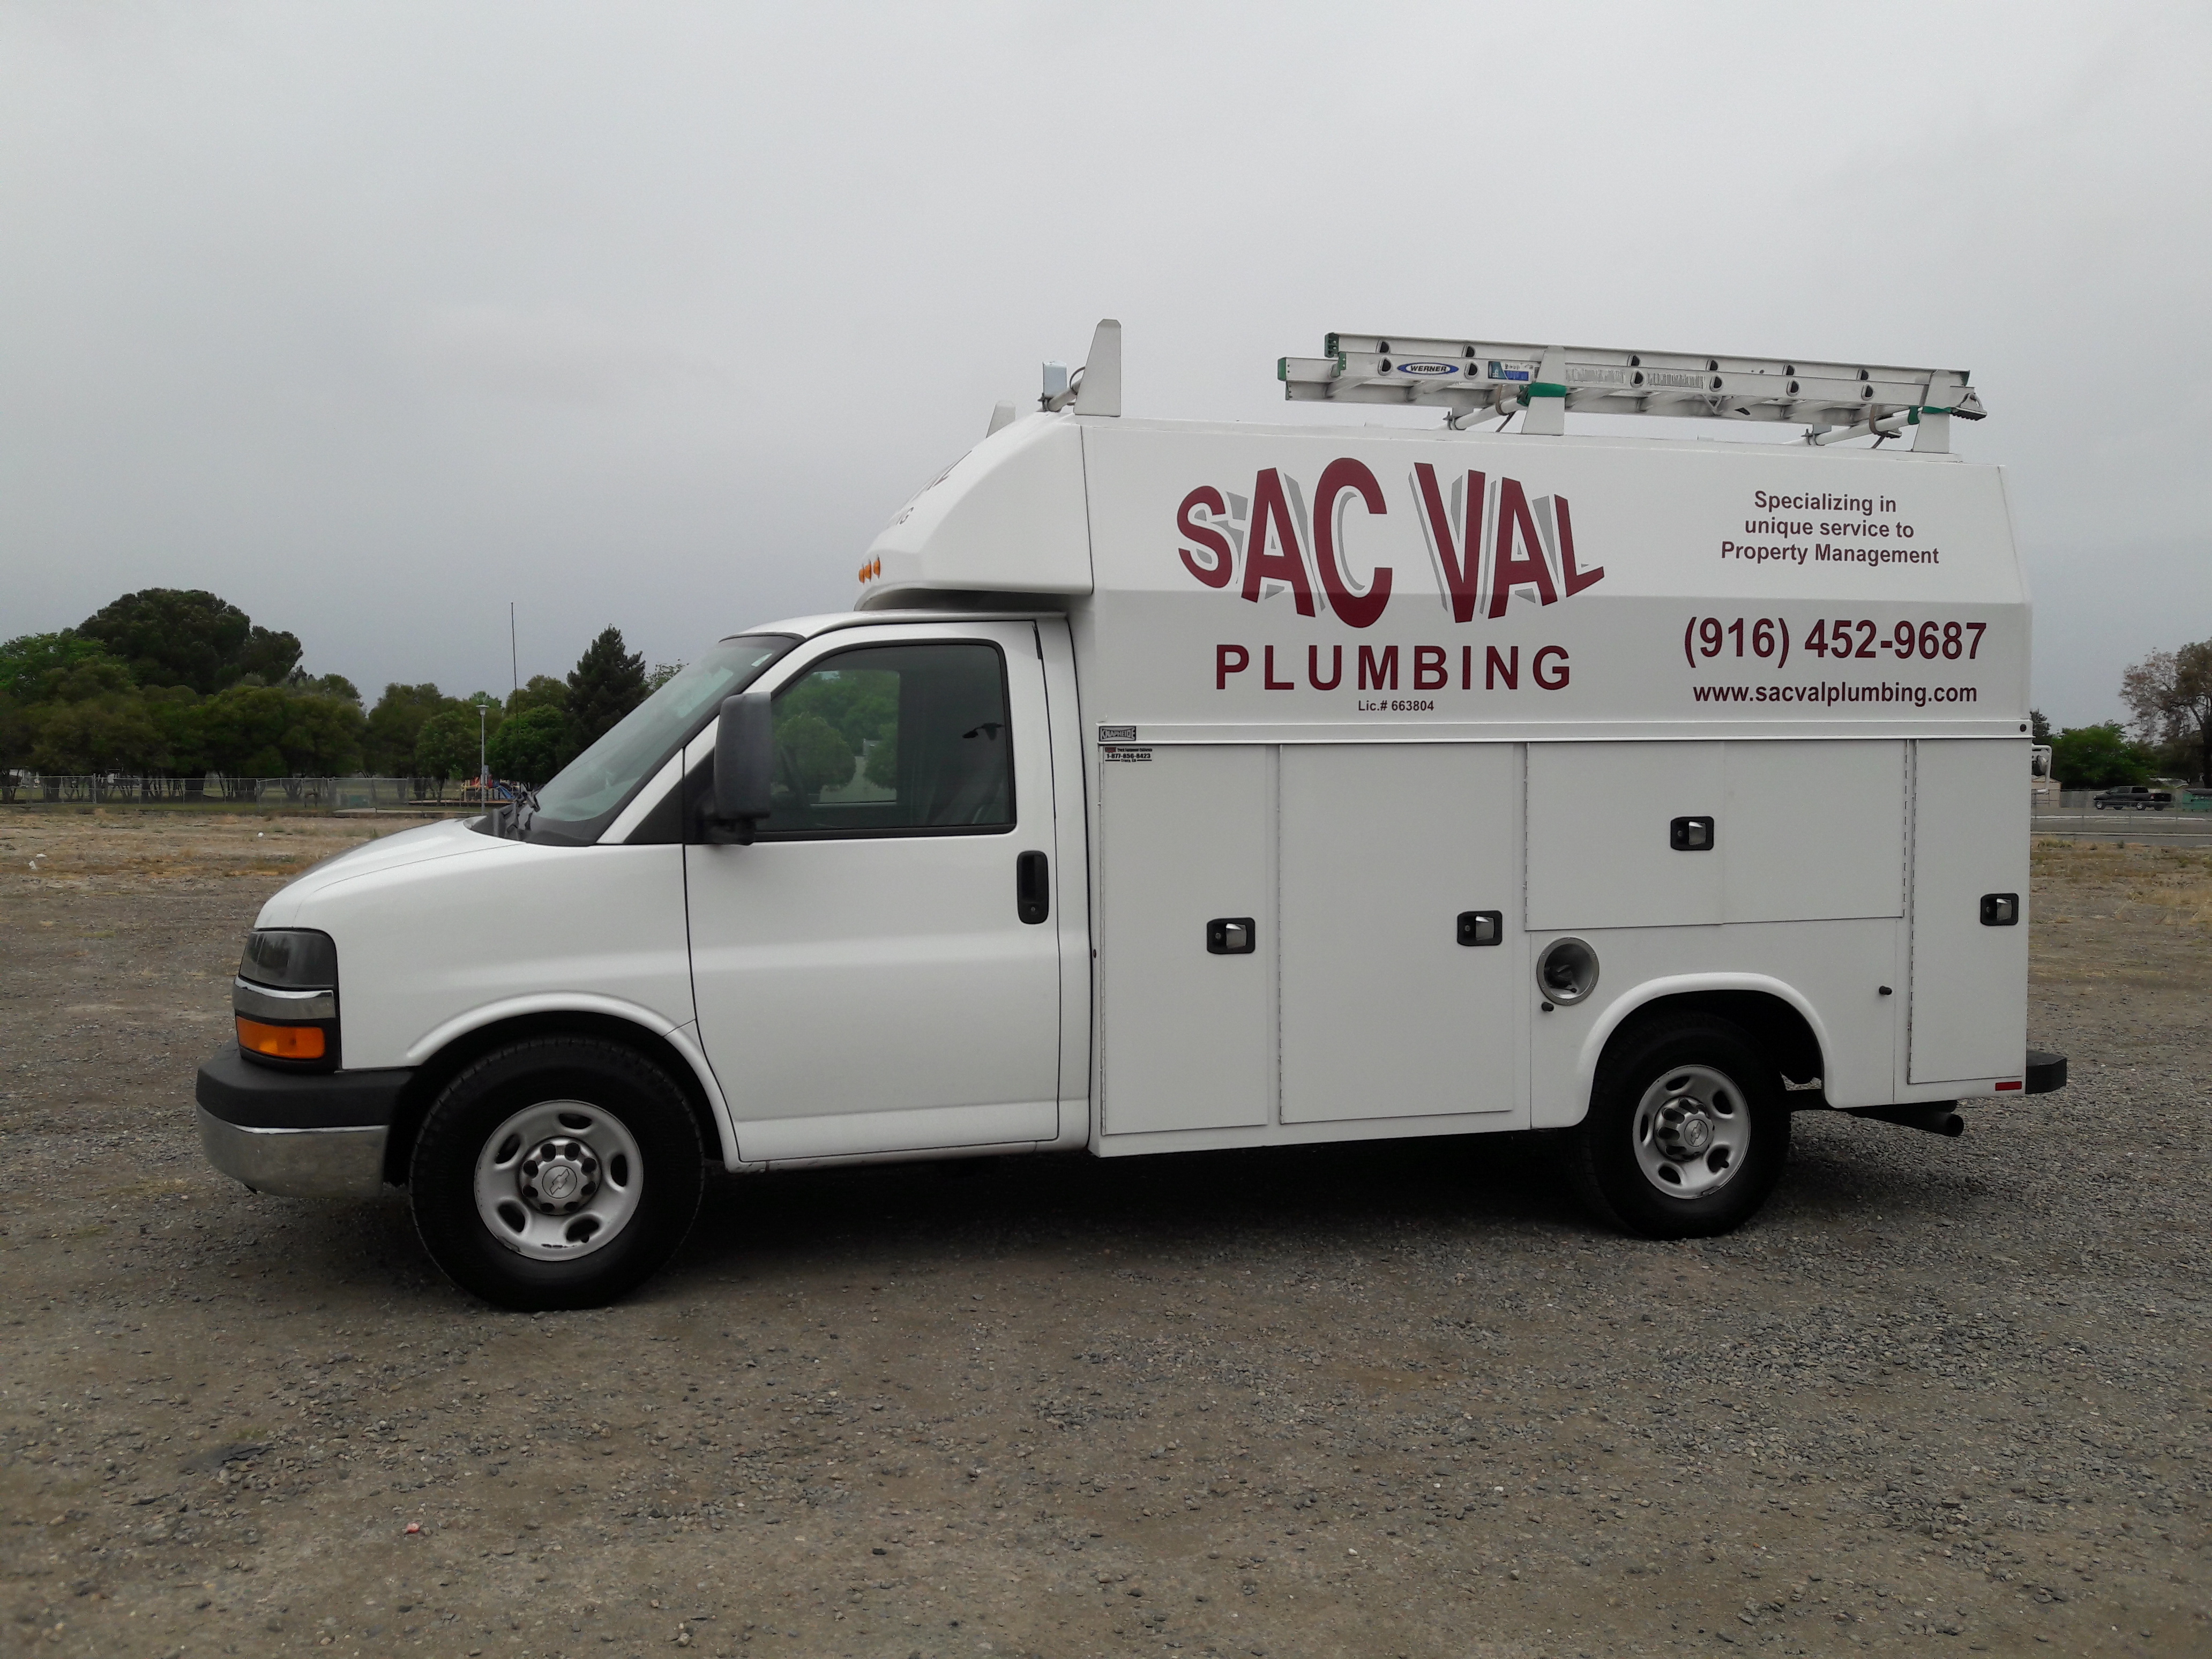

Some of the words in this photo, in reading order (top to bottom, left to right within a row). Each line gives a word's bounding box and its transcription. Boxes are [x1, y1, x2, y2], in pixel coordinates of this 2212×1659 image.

[1754, 490, 1873, 516] Specializing
[1880, 495, 1896, 512] in
[1745, 517, 1813, 539] unique
[1819, 520, 1889, 537] service
[1895, 521, 1914, 538] to
[1177, 458, 1393, 628] SAC
[1414, 462, 1604, 623] VAL
[1721, 541, 1809, 565] Property
[1815, 543, 1940, 567] Management
[1684, 616, 1790, 669] (916)
[1804, 618, 1987, 660] 452-9687
[1215, 644, 1570, 691] PLUMBING
[1358, 699, 1388, 712] Lic.#
[1391, 699, 1435, 712] 663804
[1692, 681, 1977, 707] www.sacvalplumbing.com
[1100, 727, 1135, 740] KNAPHEIDE
